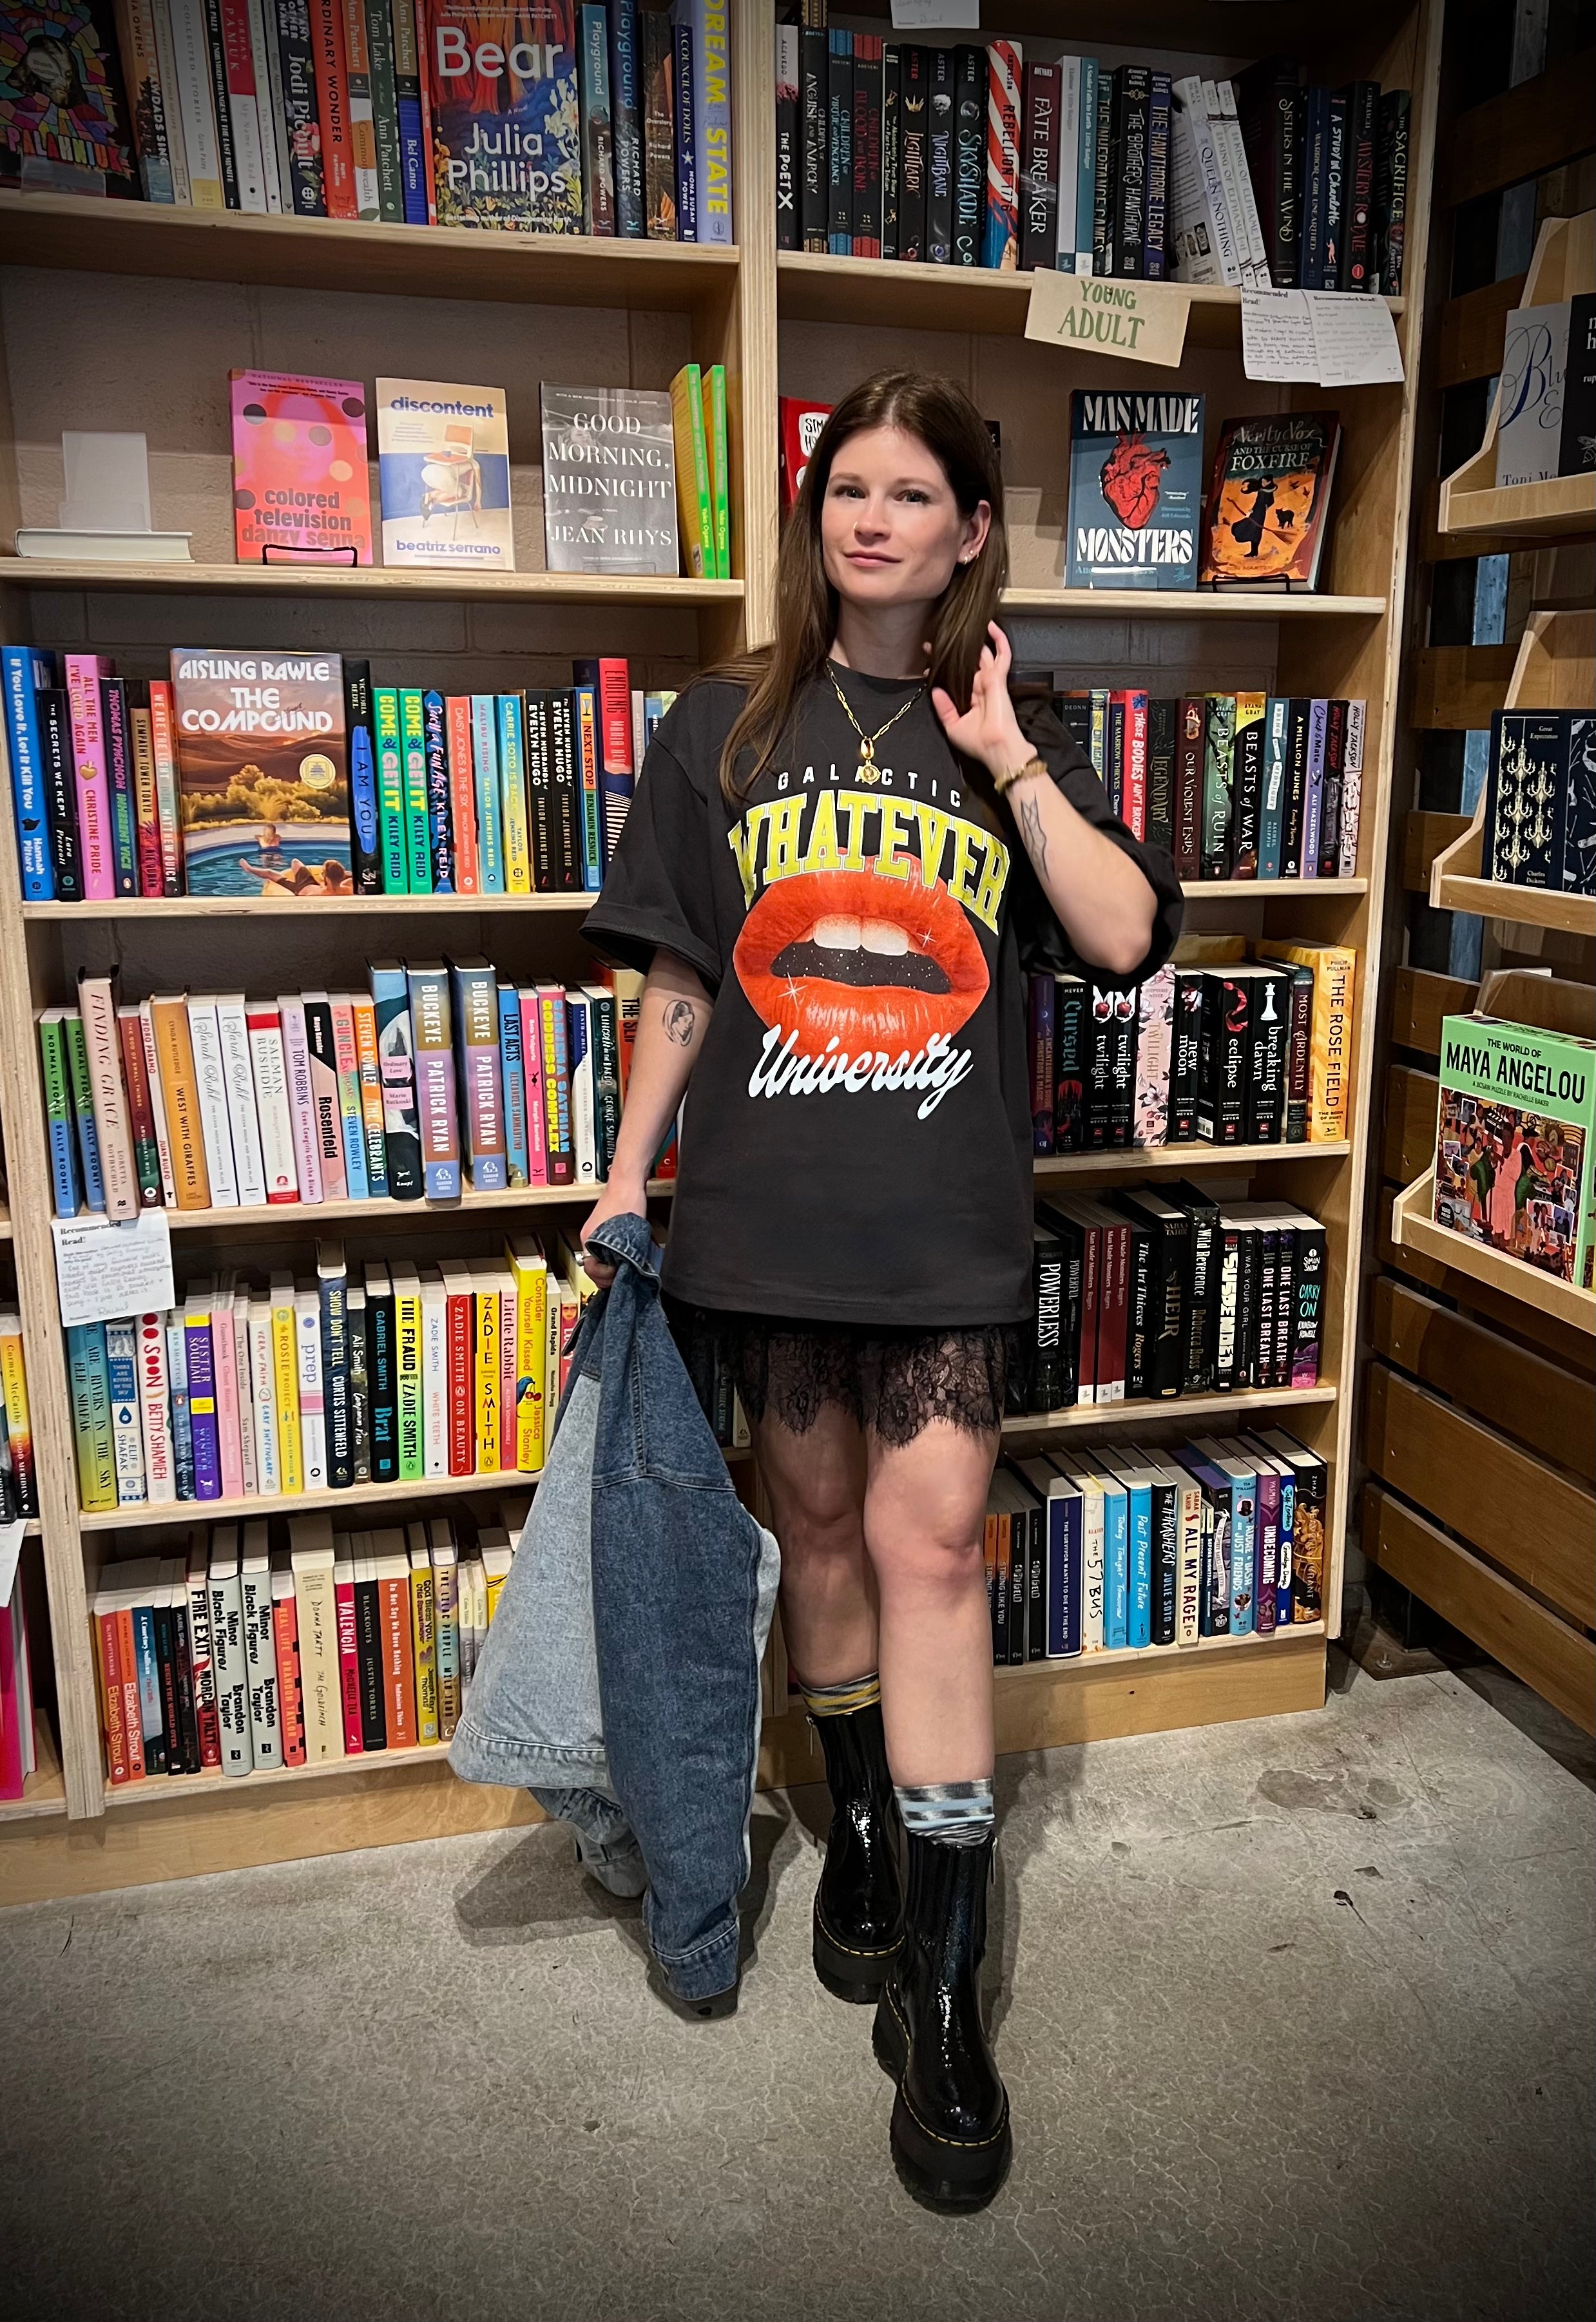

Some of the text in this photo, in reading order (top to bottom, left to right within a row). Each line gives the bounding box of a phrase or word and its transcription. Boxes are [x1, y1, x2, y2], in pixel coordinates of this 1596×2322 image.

[370, 10, 385, 70] Tom Lake
[437, 26, 563, 79] Bear
[592, 21, 605, 95] Playground
[289, 53, 314, 169] Jodi Picoult
[464, 122, 543, 155] Julia
[1128, 108, 1145, 130] THE
[1151, 106, 1169, 135] THE
[379, 114, 394, 191] Ann Patchett
[407, 139, 417, 190] Bel Canto
[706, 128, 728, 215] STATE
[778, 131, 793, 209] THE POET X
[958, 130, 981, 225] SKYSHADE
[1030, 97, 1052, 233] FATE BREAKER
[1122, 133, 1144, 185] BROTHERS
[1149, 138, 1168, 203] HAWTHORNE
[1279, 99, 1294, 242] SISTERS IN THE WIND
[1392, 131, 1407, 220] SACRIFICE
[448, 160, 566, 202] Phillips
[1122, 187, 1142, 247] HAWTHORNE
[1147, 204, 1164, 251] LEGACY
[1080, 280, 1137, 310] YOUNG
[1057, 305, 1145, 349] ADULT
[390, 396, 494, 418] discontent
[573, 412, 641, 435] GOOD
[549, 441, 670, 470] MORNING,
[1230, 452, 1310, 472] FOXFIRE
[264, 488, 340, 509] colored
[549, 474, 671, 499] MIDNIGHT
[254, 508, 351, 531] television
[396, 539, 501, 555] beatriz serrano
[550, 524, 672, 546] JEAN RHYS
[1076, 528, 1193, 564] MONSTERS
[179, 660, 330, 681] AISLING RAWLE
[230, 687, 280, 709] THE
[605, 670, 628, 713] ENDLING
[182, 709, 333, 733] COMPOUND
[529, 704, 541, 787] EVELYN HUGO
[358, 760, 368, 787] AM
[582, 724, 594, 785] NEXT STOP
[379, 695, 401, 879] COME & GET IT KILEY REID
[1182, 753, 1197, 855] OUR VIOLENT ENDS
[1211, 728, 1229, 852] BEASTS of RUIN
[1238, 732, 1258, 855] BEASTS of WAR
[85, 789, 101, 874] CHRISTINE PRIDE
[360, 799, 372, 834] YOU
[586, 793, 597, 862] BENJAMIN RESNICK
[1309, 806, 1318, 855] HAZELWOOD
[727, 789, 1010, 936] WHATEVER
[421, 984, 442, 1044] BUCKEYE
[1325, 975, 1345, 1107] THE ROSE FIELD
[90, 993, 119, 1129] FINDING GRACE
[747, 1023, 974, 1120] University
[1091, 1035, 1110, 1090] twilight
[1177, 1035, 1188, 1077] moon
[1187, 1040, 1198, 1071] new
[1223, 1039, 1243, 1088] eclipse
[1253, 1041, 1267, 1080] dawn
[1261, 1026, 1283, 1091] breaking
[1446, 1041, 1586, 1104] MAYA ANGELOU
[1487, 1037, 1541, 1059] THE WORLD OF
[293, 1049, 309, 1106] TOM ROBBINS
[318, 1097, 338, 1160] Rosenfeld
[427, 1060, 450, 1152] PATRICK RYAN
[55, 1124, 69, 1197] SALLY ROONEY
[176, 1087, 197, 1187] WEST WITH GIRAFFES
[60, 1220, 122, 1236] Recommended
[61, 1236, 86, 1247] Read!
[1037, 1263, 1061, 1348] POWERLESS
[1259, 1268, 1274, 1363] ONE LAST BREATH
[1299, 1284, 1321, 1301] CARRY
[1300, 1302, 1317, 1317] ON
[329, 1290, 343, 1367] SHOW DON'T TELL
[400, 1298, 416, 1371] THE FRAUD
[144, 1344, 164, 1389] SOON
[301, 1343, 316, 1383] prep
[454, 1306, 466, 1464] ZADIE SMITH ON BEAUTY
[148, 1403, 166, 1481] BETTY SHAMIEH
[332, 1375, 347, 1457] CURTIS SITTENFELD
[374, 1406, 392, 1443] Brat
[402, 1383, 416, 1459] ZADIE SMITH
[1114, 1515, 1125, 1540] Today
[1262, 1525, 1276, 1584] UNBECOMING
[1114, 1546, 1124, 1577] Tonight
[1137, 1515, 1148, 1609] Past Present Future
[1182, 1527, 1198, 1624] ALL MY RAGE
[191, 1590, 211, 1656] FIRE EXIT
[211, 1590, 227, 1671] Black Figures
[226, 1611, 238, 1647] Minor
[338, 1601, 356, 1655] VALENCIA
[220, 1692, 232, 1729] Taylor
[232, 1684, 245, 1734] Brandon
